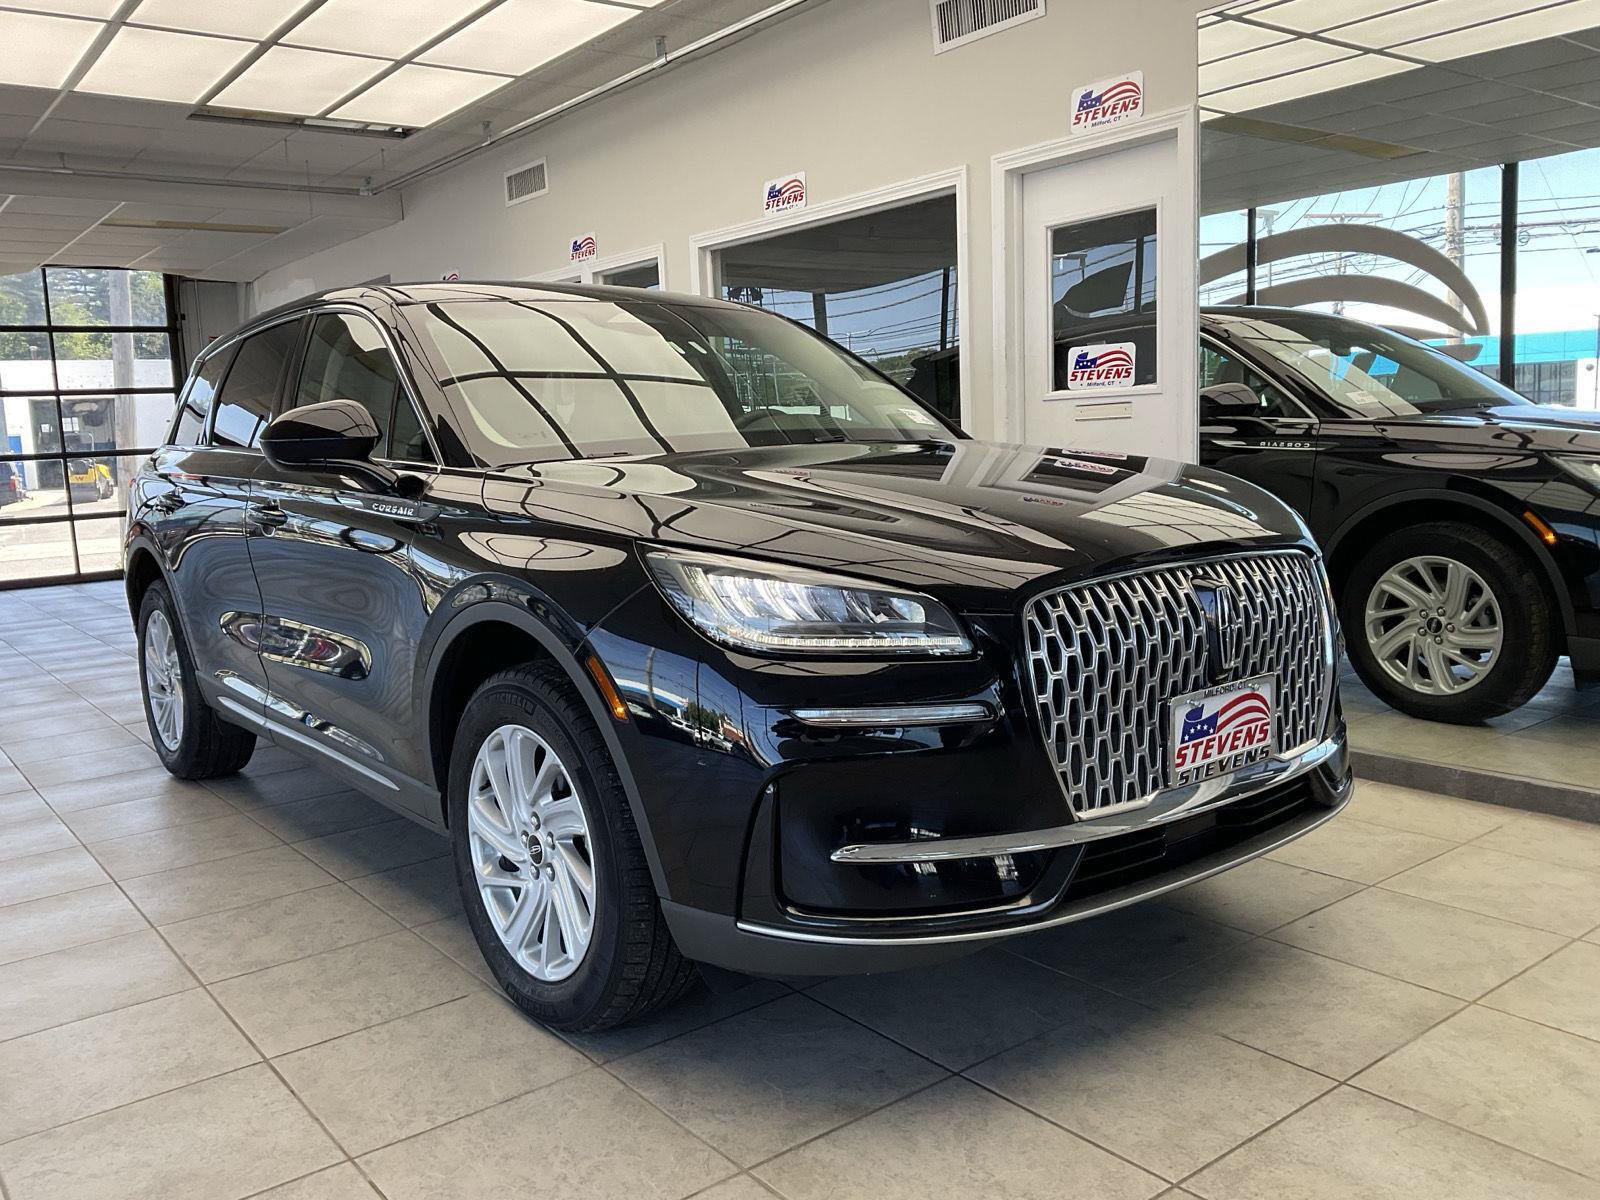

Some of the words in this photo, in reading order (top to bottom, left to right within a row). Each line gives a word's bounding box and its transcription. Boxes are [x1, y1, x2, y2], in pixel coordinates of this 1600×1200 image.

[1073, 97, 1141, 126] STEVENS
[1113, 115, 1122, 123] CT
[765, 191, 805, 211] STEVENS
[570, 247, 596, 261] STEVENS
[1070, 367, 1133, 382] STEVENS
[372, 502, 415, 516] CORSAIR
[1175, 720, 1271, 768] STEVENS
[1177, 745, 1271, 786] STEVENS
